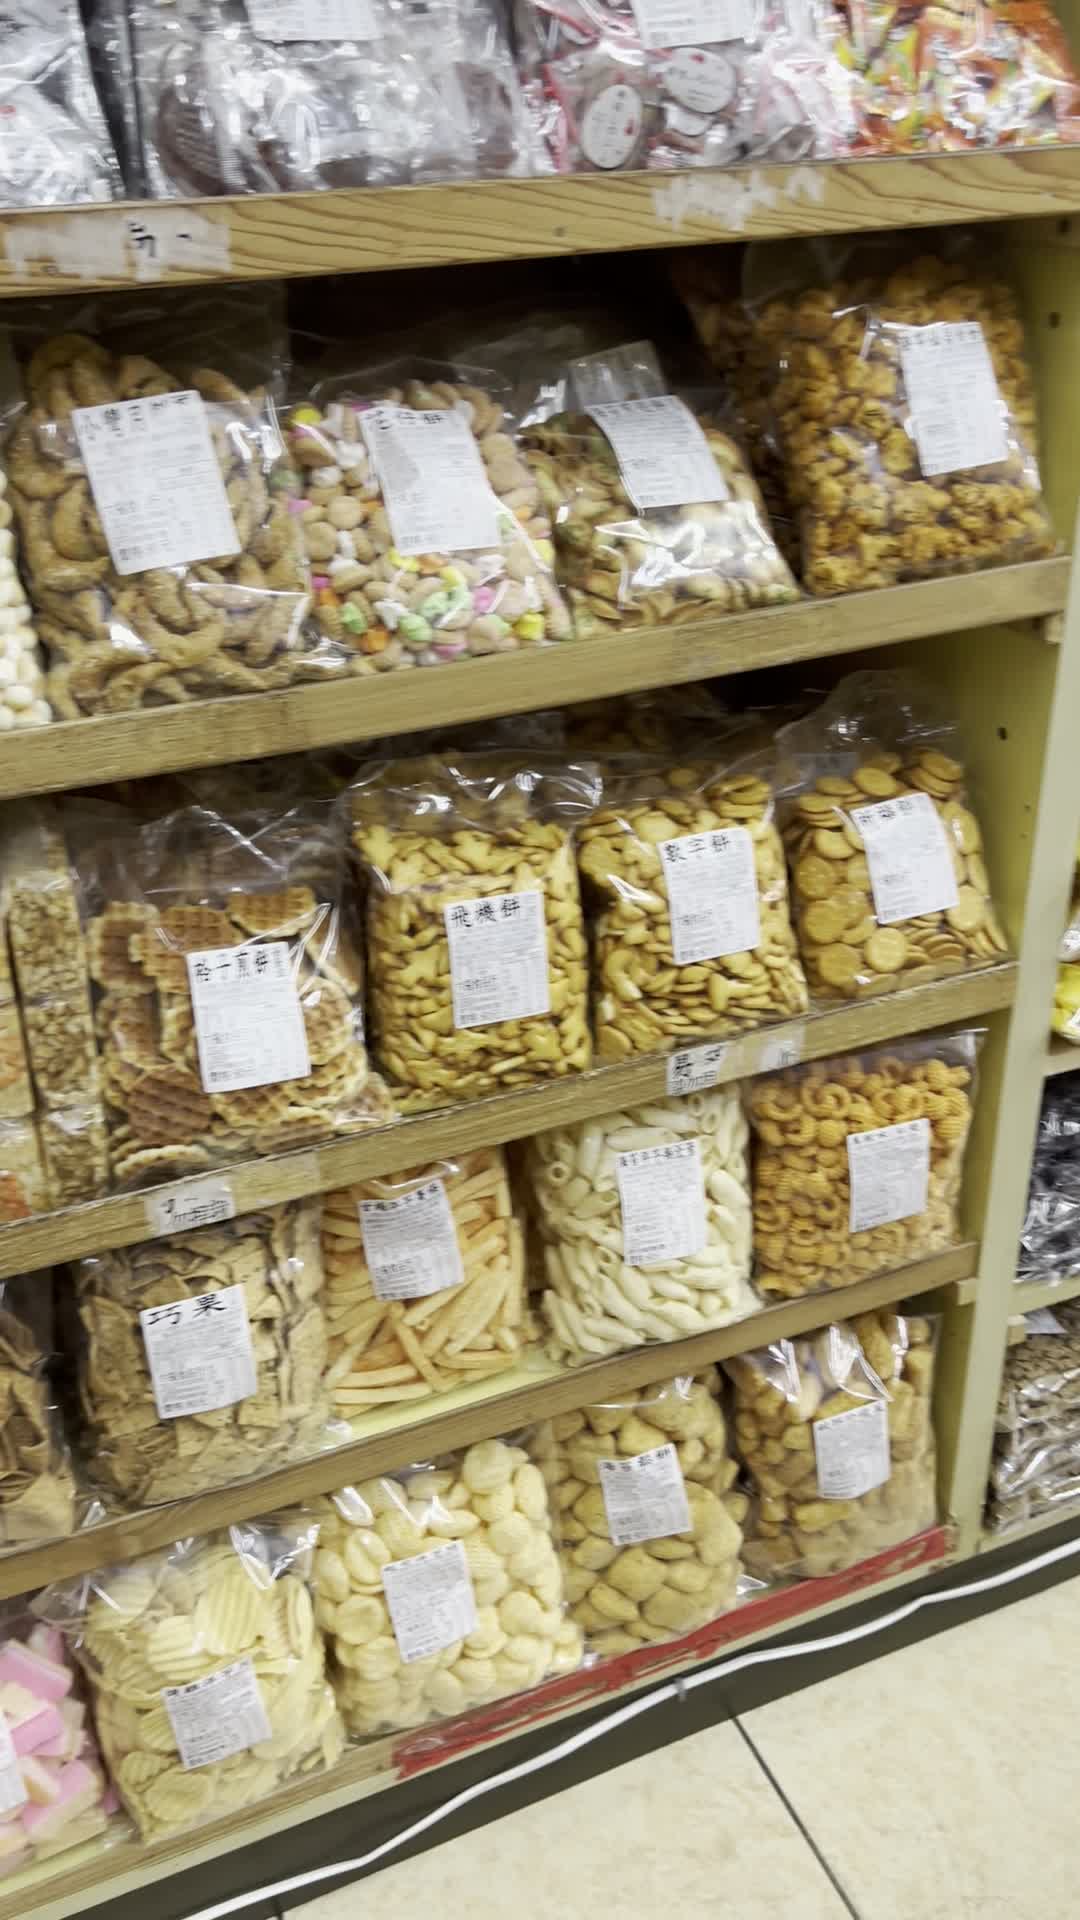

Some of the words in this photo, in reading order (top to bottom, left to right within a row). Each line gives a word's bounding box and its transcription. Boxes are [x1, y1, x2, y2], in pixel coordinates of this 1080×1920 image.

[450, 895, 521, 929] 飛機餅
[146, 1292, 226, 1326] 巧果
